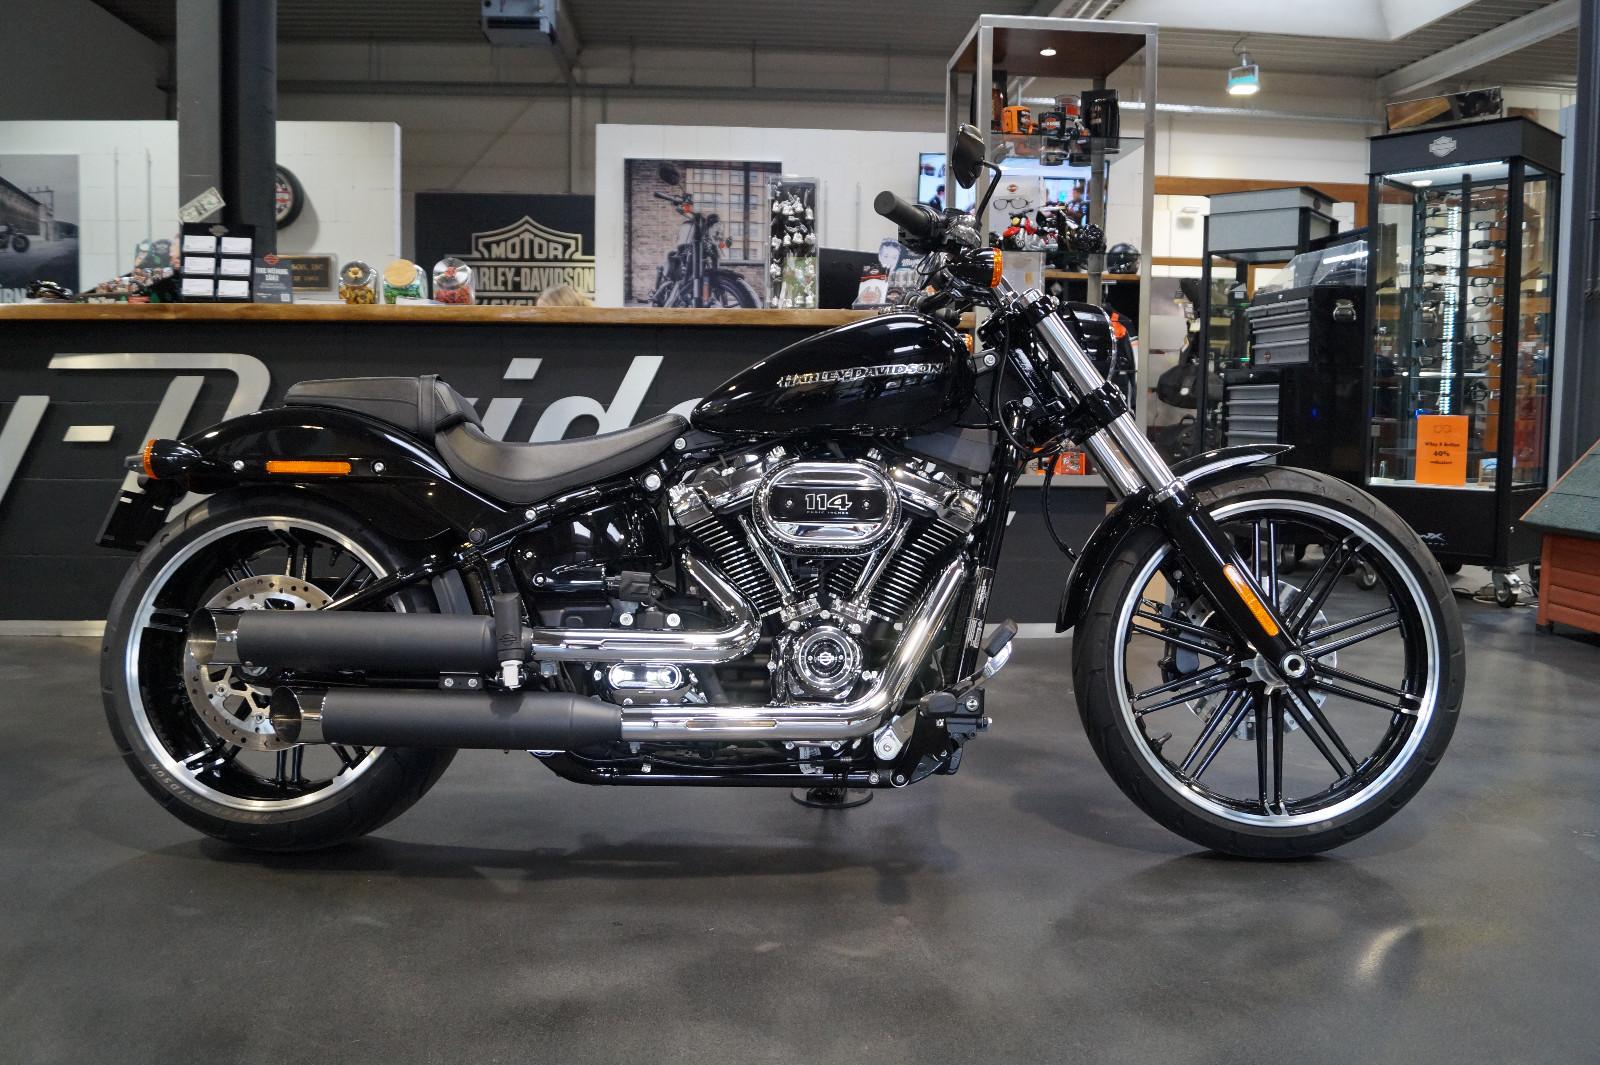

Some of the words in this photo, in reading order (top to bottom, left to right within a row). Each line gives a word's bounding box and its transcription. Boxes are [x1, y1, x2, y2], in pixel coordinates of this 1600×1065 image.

[491, 231, 565, 259] MOTOR
[777, 363, 943, 387] HARLEY-DAVIDSON
[805, 493, 853, 510] 114
